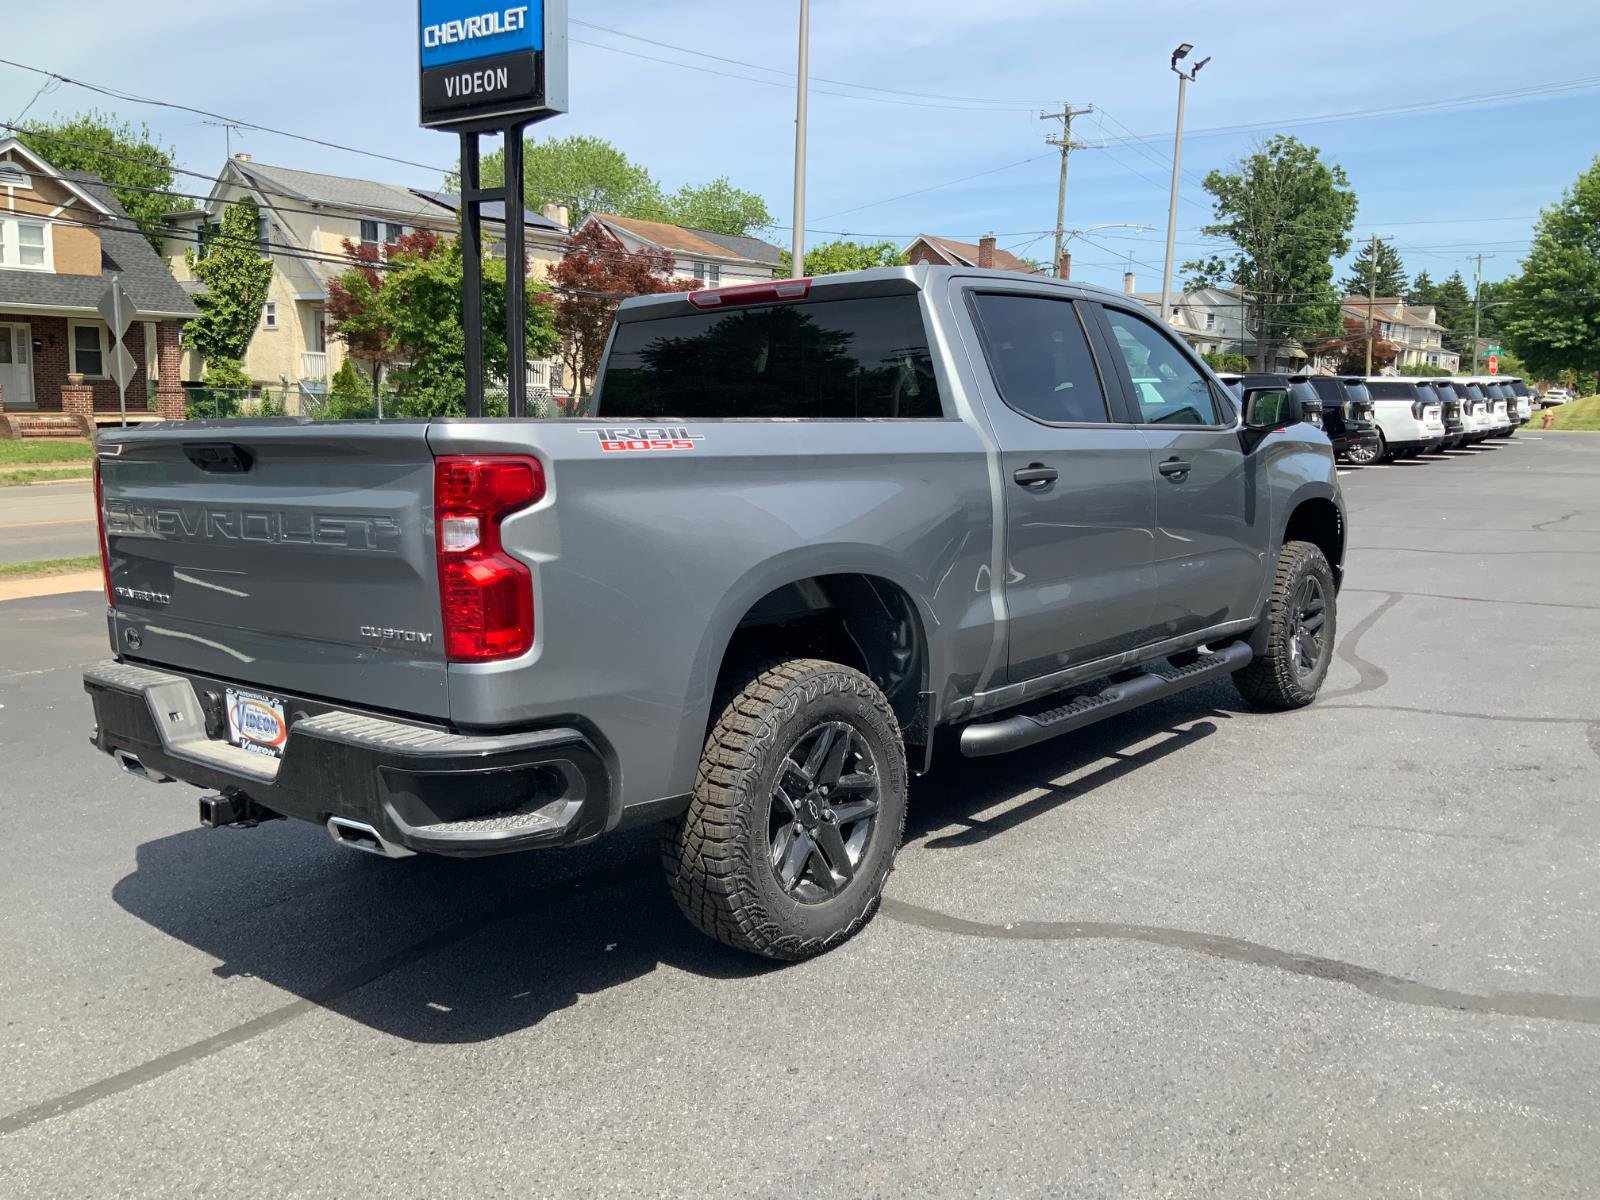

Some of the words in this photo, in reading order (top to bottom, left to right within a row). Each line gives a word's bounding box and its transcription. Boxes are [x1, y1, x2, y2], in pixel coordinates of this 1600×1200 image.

[424, 6, 528, 48] CHEVROLET
[444, 67, 508, 98] VIDEON
[577, 426, 706, 441] TRAIL
[600, 439, 695, 453] BOSS
[107, 501, 396, 549] CHEVROLET
[360, 626, 433, 644] CUSTOM
